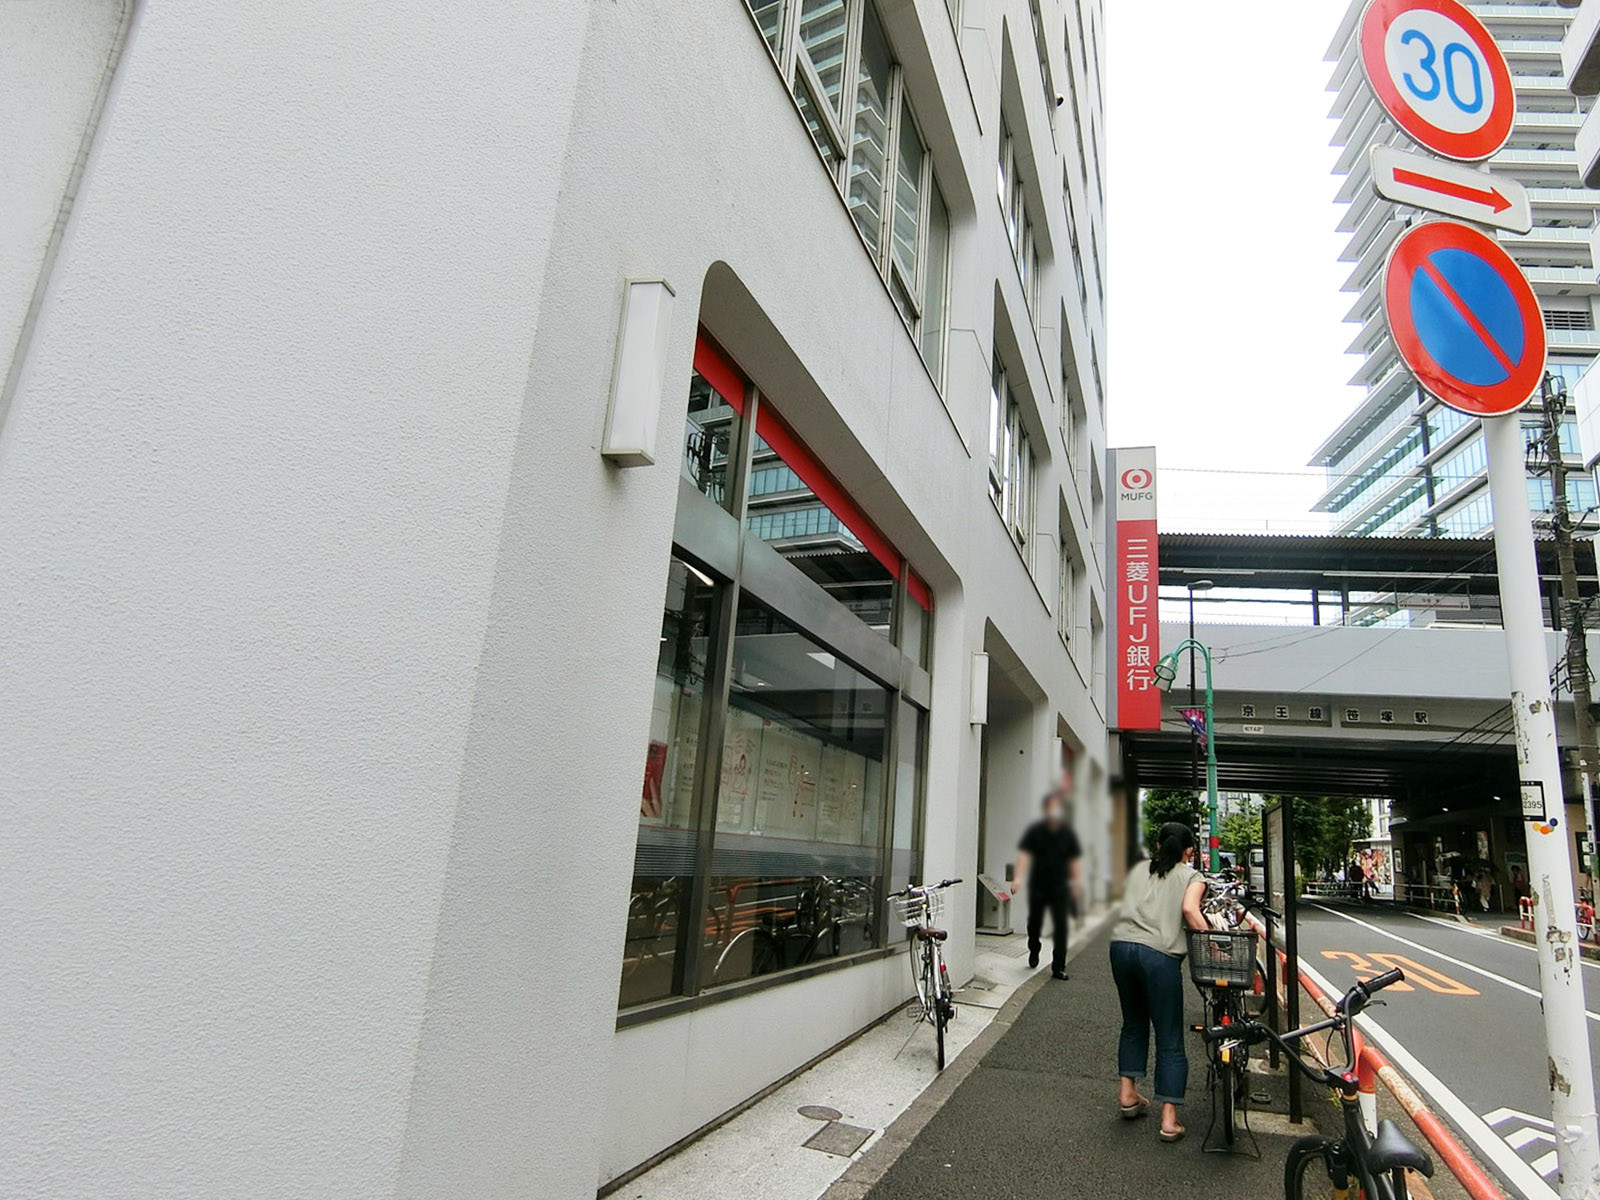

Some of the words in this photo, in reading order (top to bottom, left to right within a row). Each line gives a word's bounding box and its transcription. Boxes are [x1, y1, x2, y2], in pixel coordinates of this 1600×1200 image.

[1401, 29, 1483, 114] 30
[1121, 492, 1153, 501] MUFG
[1126, 538, 1151, 691] 三菱UFJ銀行
[1241, 705, 1323, 721] 京王線
[1346, 709, 1428, 725] 笹塚駅
[1320, 950, 1481, 996] 30
